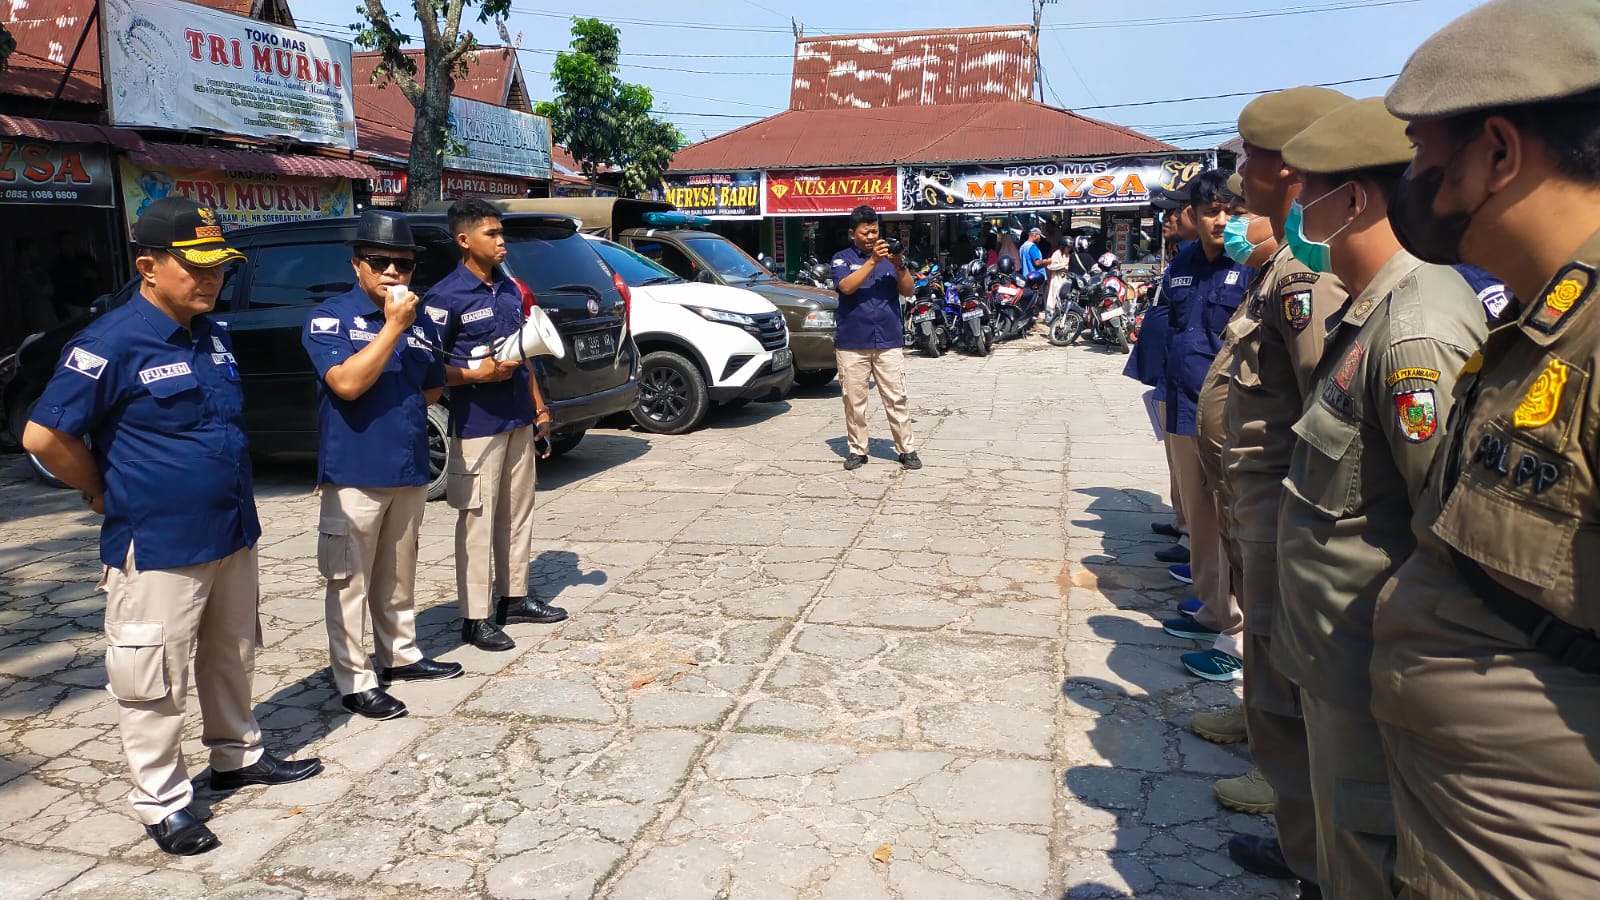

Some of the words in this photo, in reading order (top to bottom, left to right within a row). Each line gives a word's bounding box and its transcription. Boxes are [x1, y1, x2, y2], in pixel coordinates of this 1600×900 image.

[245, 28, 278, 46] TOKO
[282, 37, 306, 52] MAS
[184, 28, 244, 69] TRI
[251, 43, 342, 89] MURNI
[462, 117, 510, 147] KARYA
[1004, 165, 1057, 178] TOKO
[1064, 162, 1106, 175] MAS
[5, 190, 28, 199] 0852
[367, 178, 402, 194] BARU
[447, 178, 486, 192] KARYA
[489, 182, 518, 195] BARU
[792, 178, 892, 196] NUSANTARA
[966, 173, 1149, 201] MERYSA
[175, 180, 229, 210] TRI
[233, 183, 321, 212] MURNI
[665, 186, 716, 207] MERYSA
[720, 186, 758, 207] BARU
[142, 364, 187, 381] FULZEN
